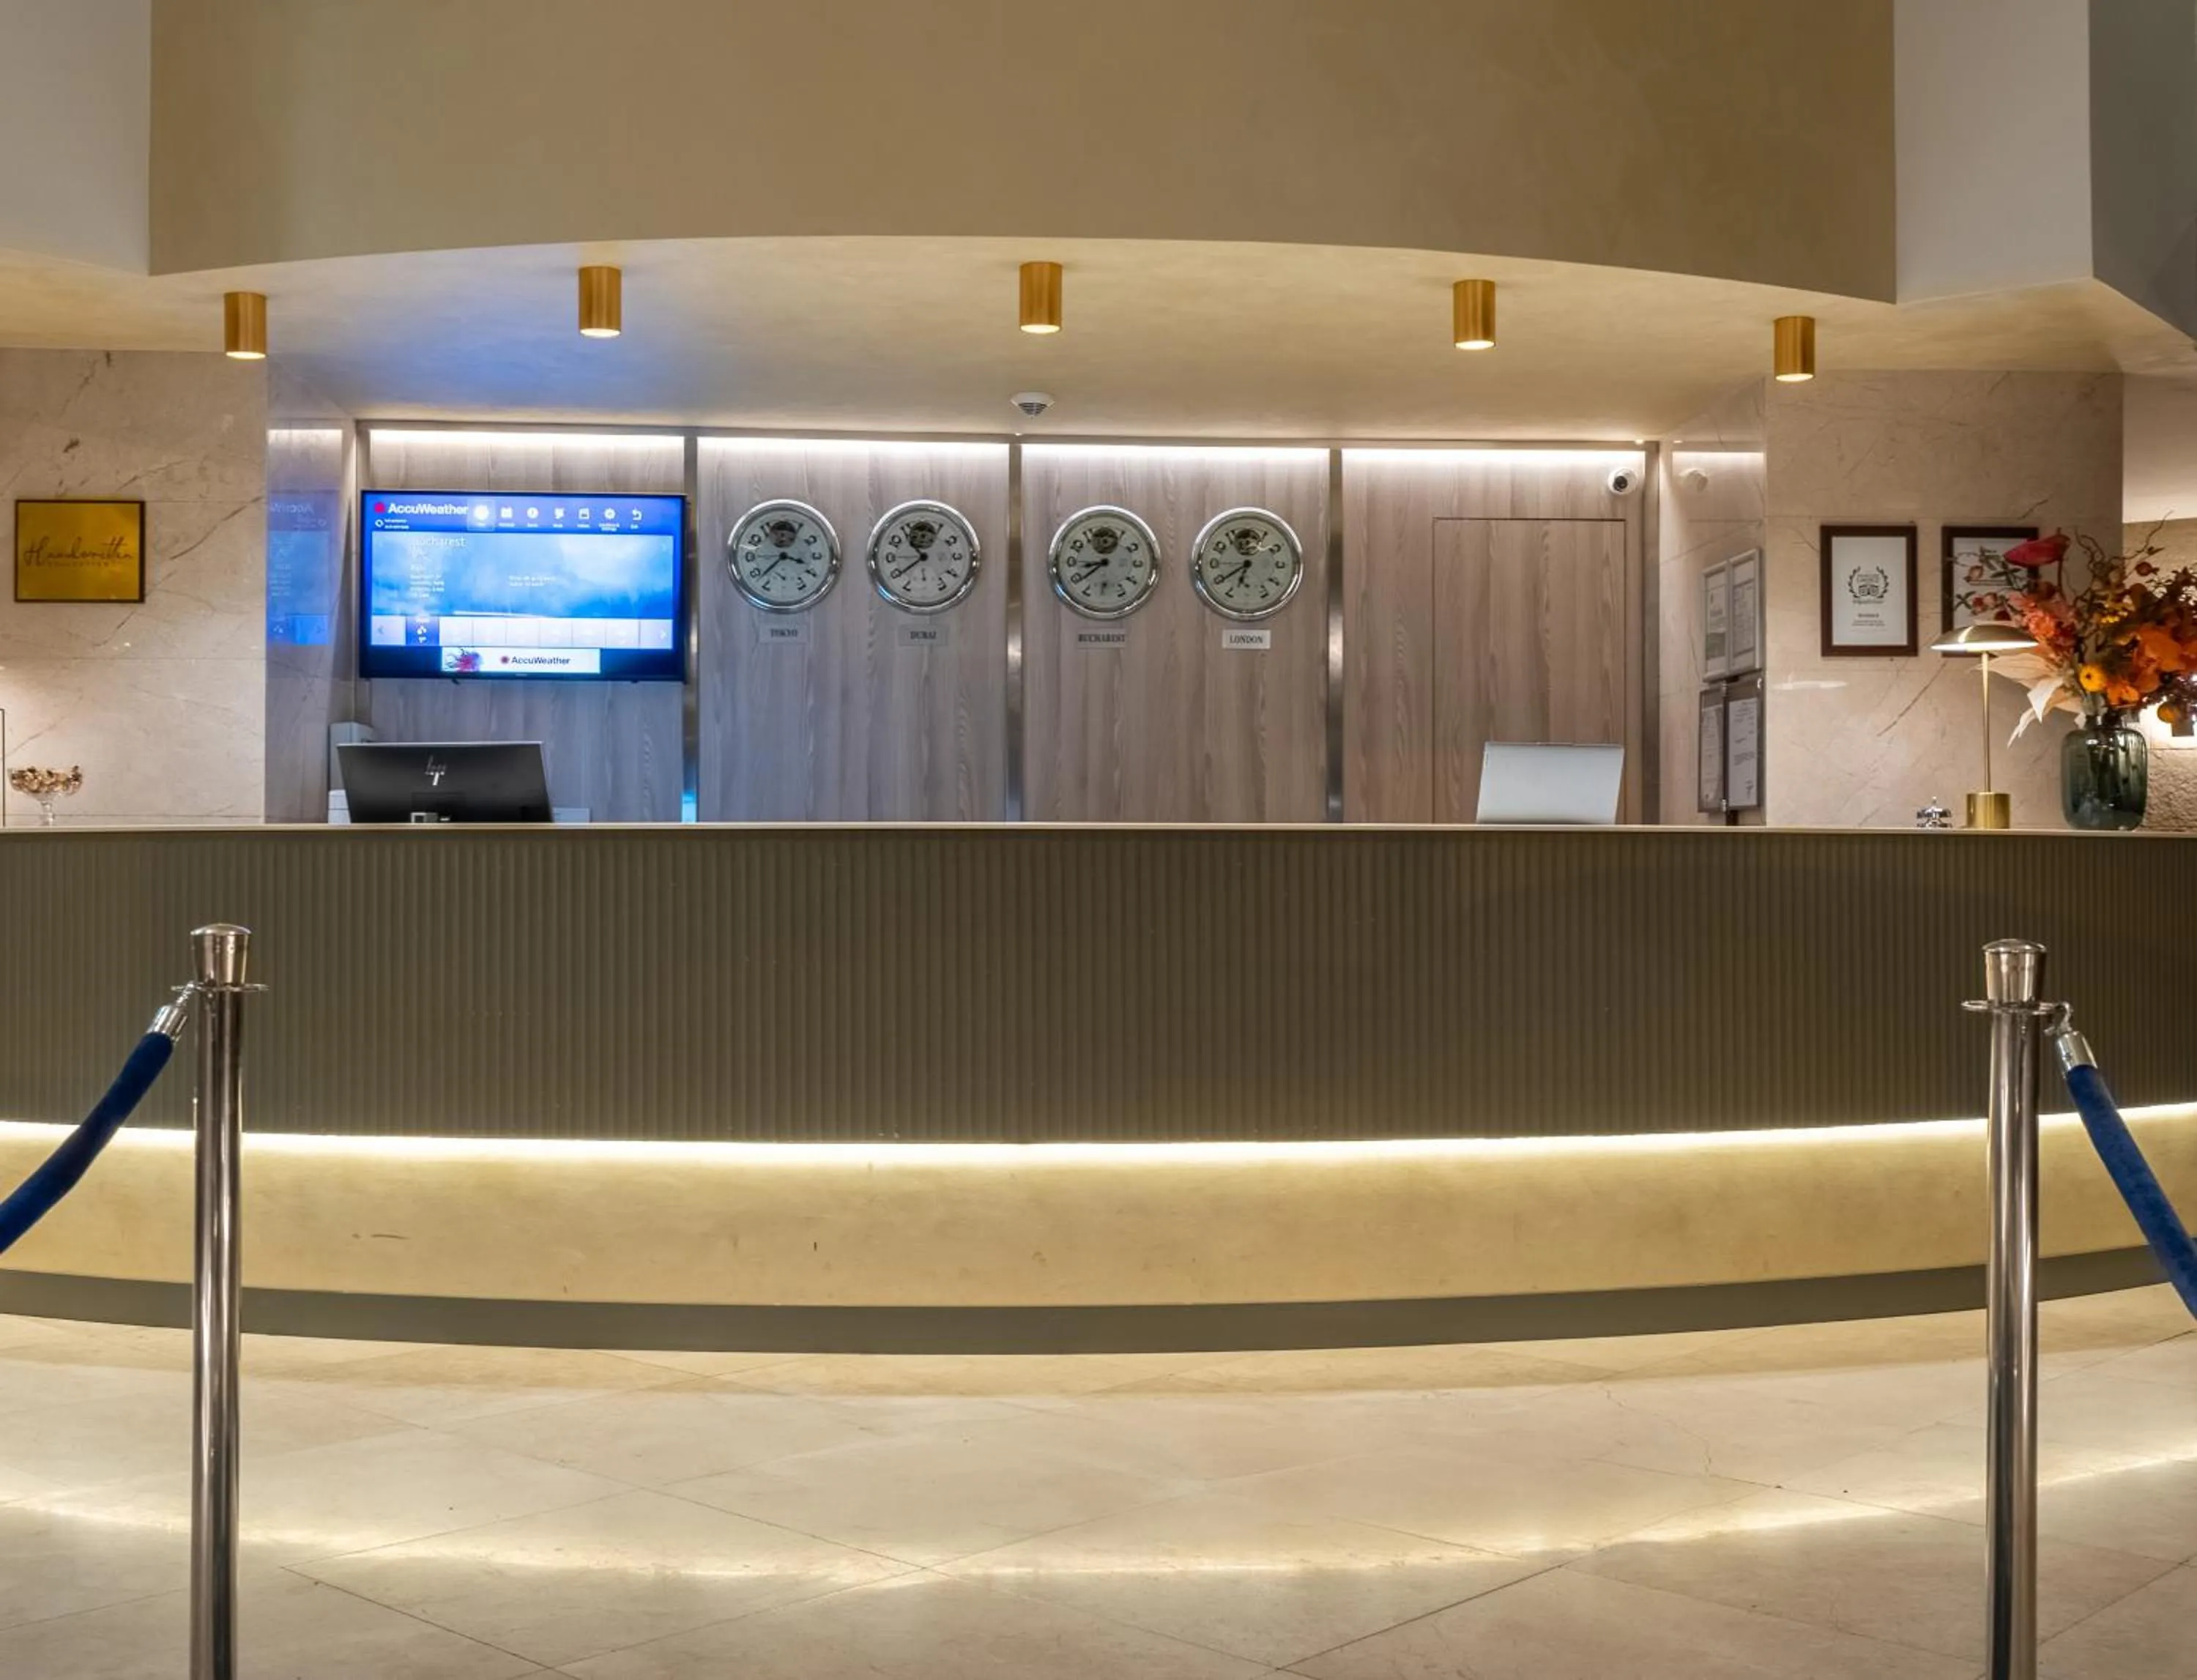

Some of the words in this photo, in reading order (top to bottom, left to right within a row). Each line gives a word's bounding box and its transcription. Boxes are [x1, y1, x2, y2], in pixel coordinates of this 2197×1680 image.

[388, 502, 469, 515] AccuWeather
[1230, 634, 1263, 644] LONDON
[512, 655, 570, 665] AccuWeather
